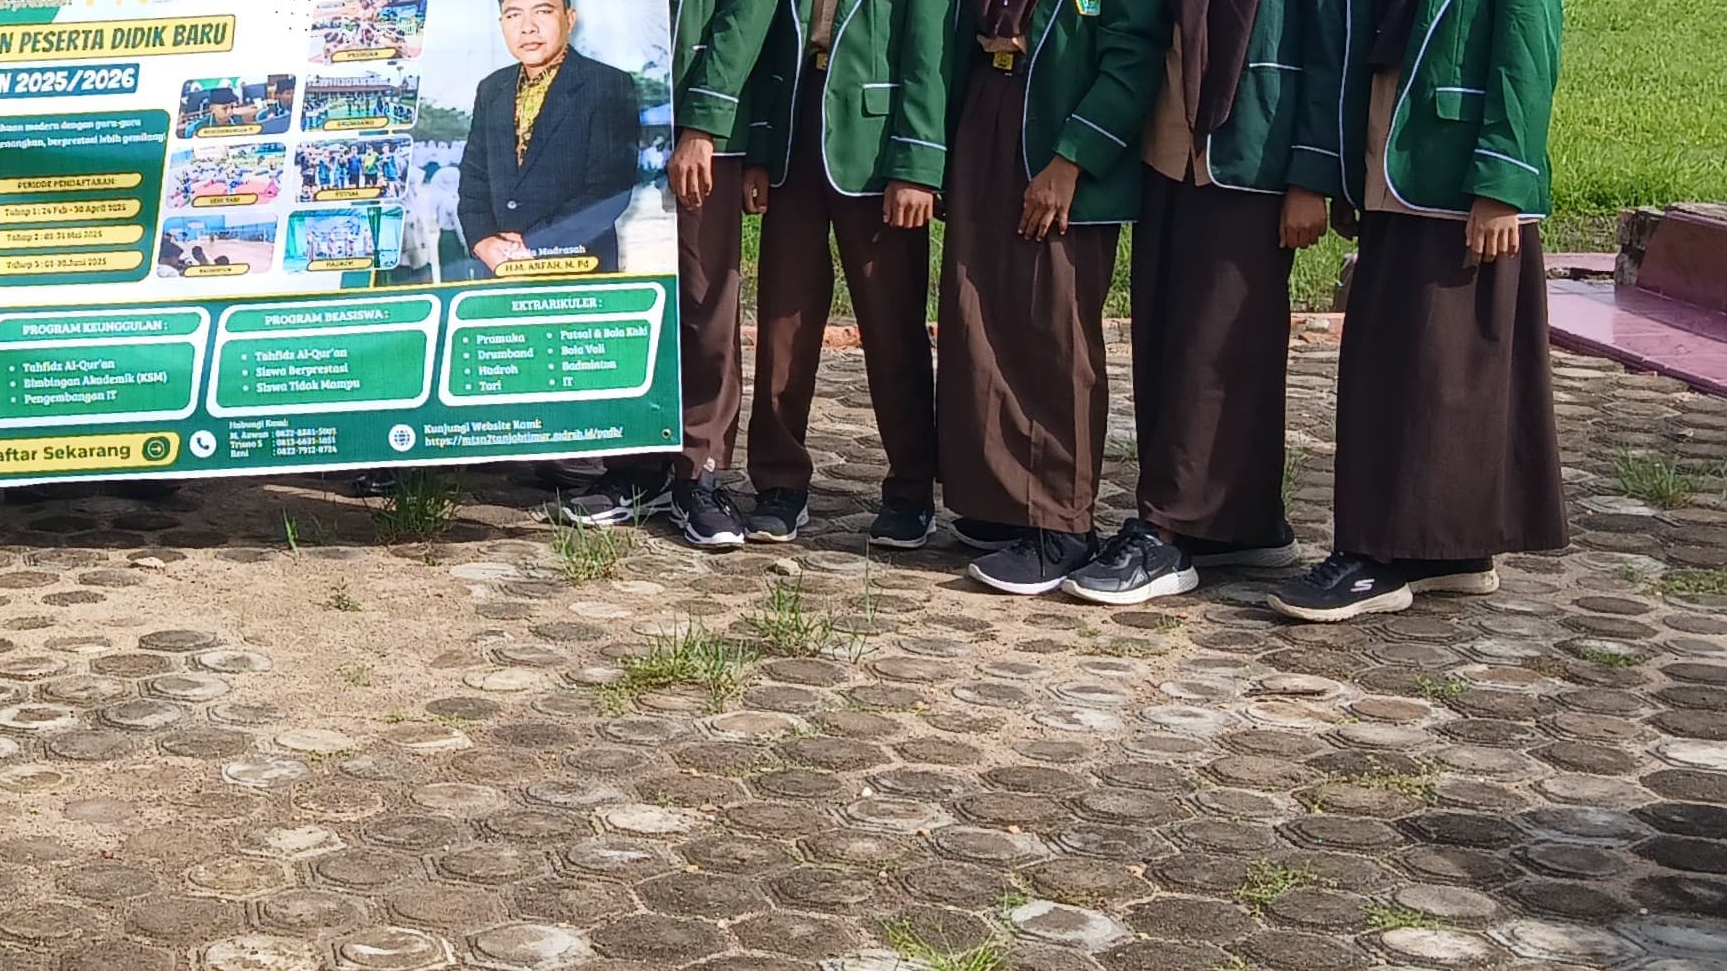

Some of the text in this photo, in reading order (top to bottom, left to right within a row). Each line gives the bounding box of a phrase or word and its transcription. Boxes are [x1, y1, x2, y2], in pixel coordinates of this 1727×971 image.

[18, 26, 104, 53] PESERTA
[111, 24, 166, 49] DIDIK
[172, 22, 228, 47] BARU
[14, 67, 136, 96] 2025/2026
[24, 120, 60, 131] modern
[60, 119, 94, 132] dengan
[95, 119, 142, 130] guru-guru
[98, 132, 122, 143] lebih
[17, 177, 115, 189] PERIODE PENDAFTARAN
[538, 245, 586, 256] Madrasah
[265, 309, 384, 326] PROGRAM BEASISWA
[22, 320, 163, 335] PROGRAM KEUNGGULAN
[603, 327, 625, 338] Bola
[476, 333, 525, 345] Pramuka
[255, 350, 295, 361] Tahfidz
[477, 347, 534, 360] Drumband
[561, 343, 606, 355] Bola Voli
[23, 359, 115, 374] Tahfidz Al-Qur'an
[255, 362, 349, 378] Siswa Berprestasi
[478, 364, 518, 376] Hadroh
[561, 359, 617, 371] Badminton
[24, 372, 168, 390] Bimbingan Akademik (KSM)
[256, 378, 360, 393] Siswa Tidak Mampu
[479, 380, 502, 391] Tari
[563, 377, 574, 387] IT
[24, 390, 117, 406] Pengembangan IT
[424, 422, 469, 436] Kunjungi
[471, 420, 511, 432] Website
[43, 443, 131, 464] Sekarang
